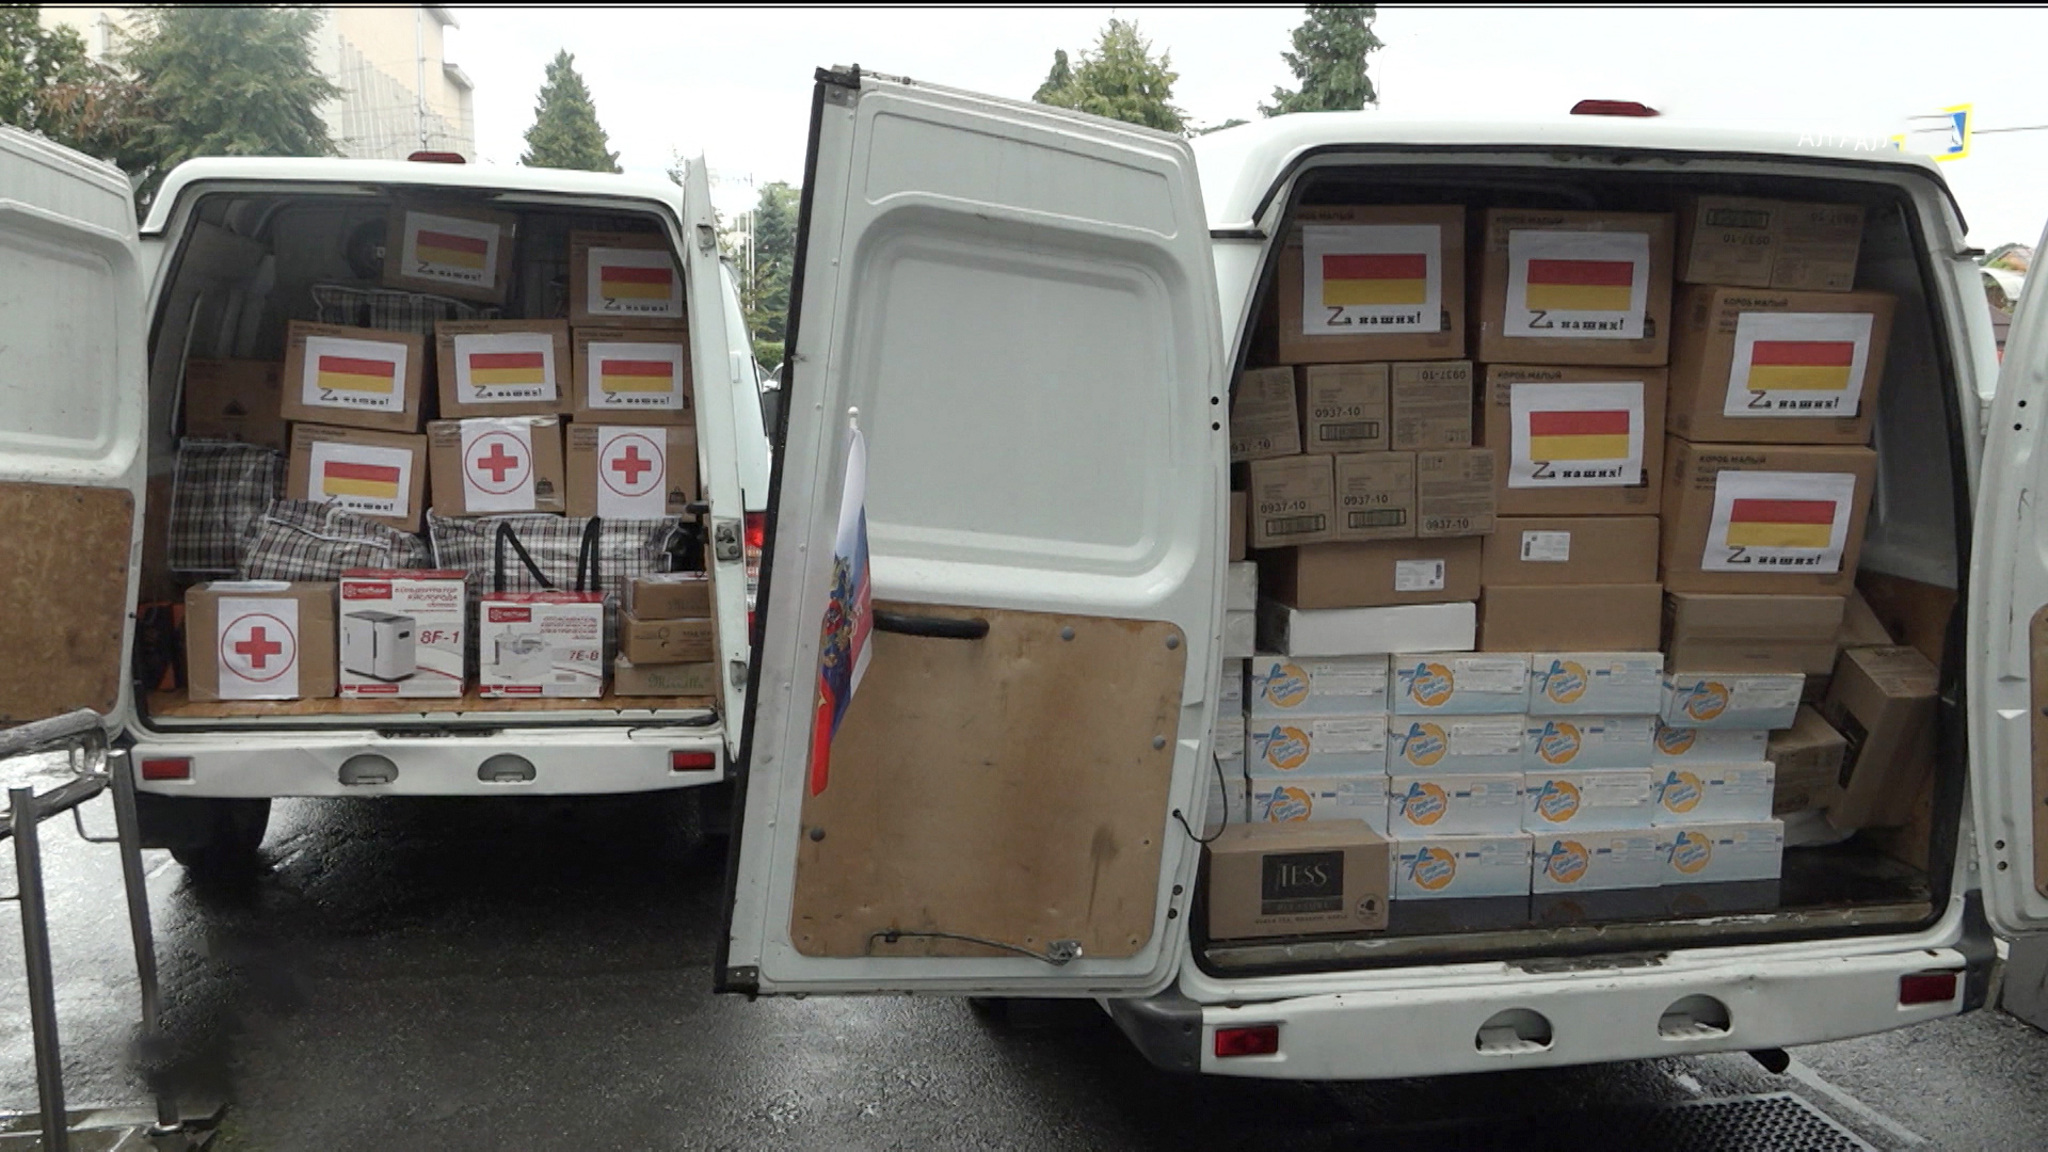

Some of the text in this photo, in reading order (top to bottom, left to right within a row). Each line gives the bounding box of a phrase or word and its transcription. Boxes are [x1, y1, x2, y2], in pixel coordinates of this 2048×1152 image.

[1359, 311, 1421, 325] наших!
[1561, 317, 1624, 331] наших!
[1778, 396, 1840, 410] наших!
[1315, 406, 1361, 418] 0937-10
[1231, 439, 1271, 454] 937-10
[1562, 464, 1623, 479] наших!
[1260, 500, 1306, 514] 0937-10
[1344, 494, 1388, 506] 0937-10
[1425, 518, 1469, 530] 0937-10
[1757, 554, 1822, 566] наших!
[420, 630, 460, 644] 8F-1
[1278, 862, 1330, 889] TESS
